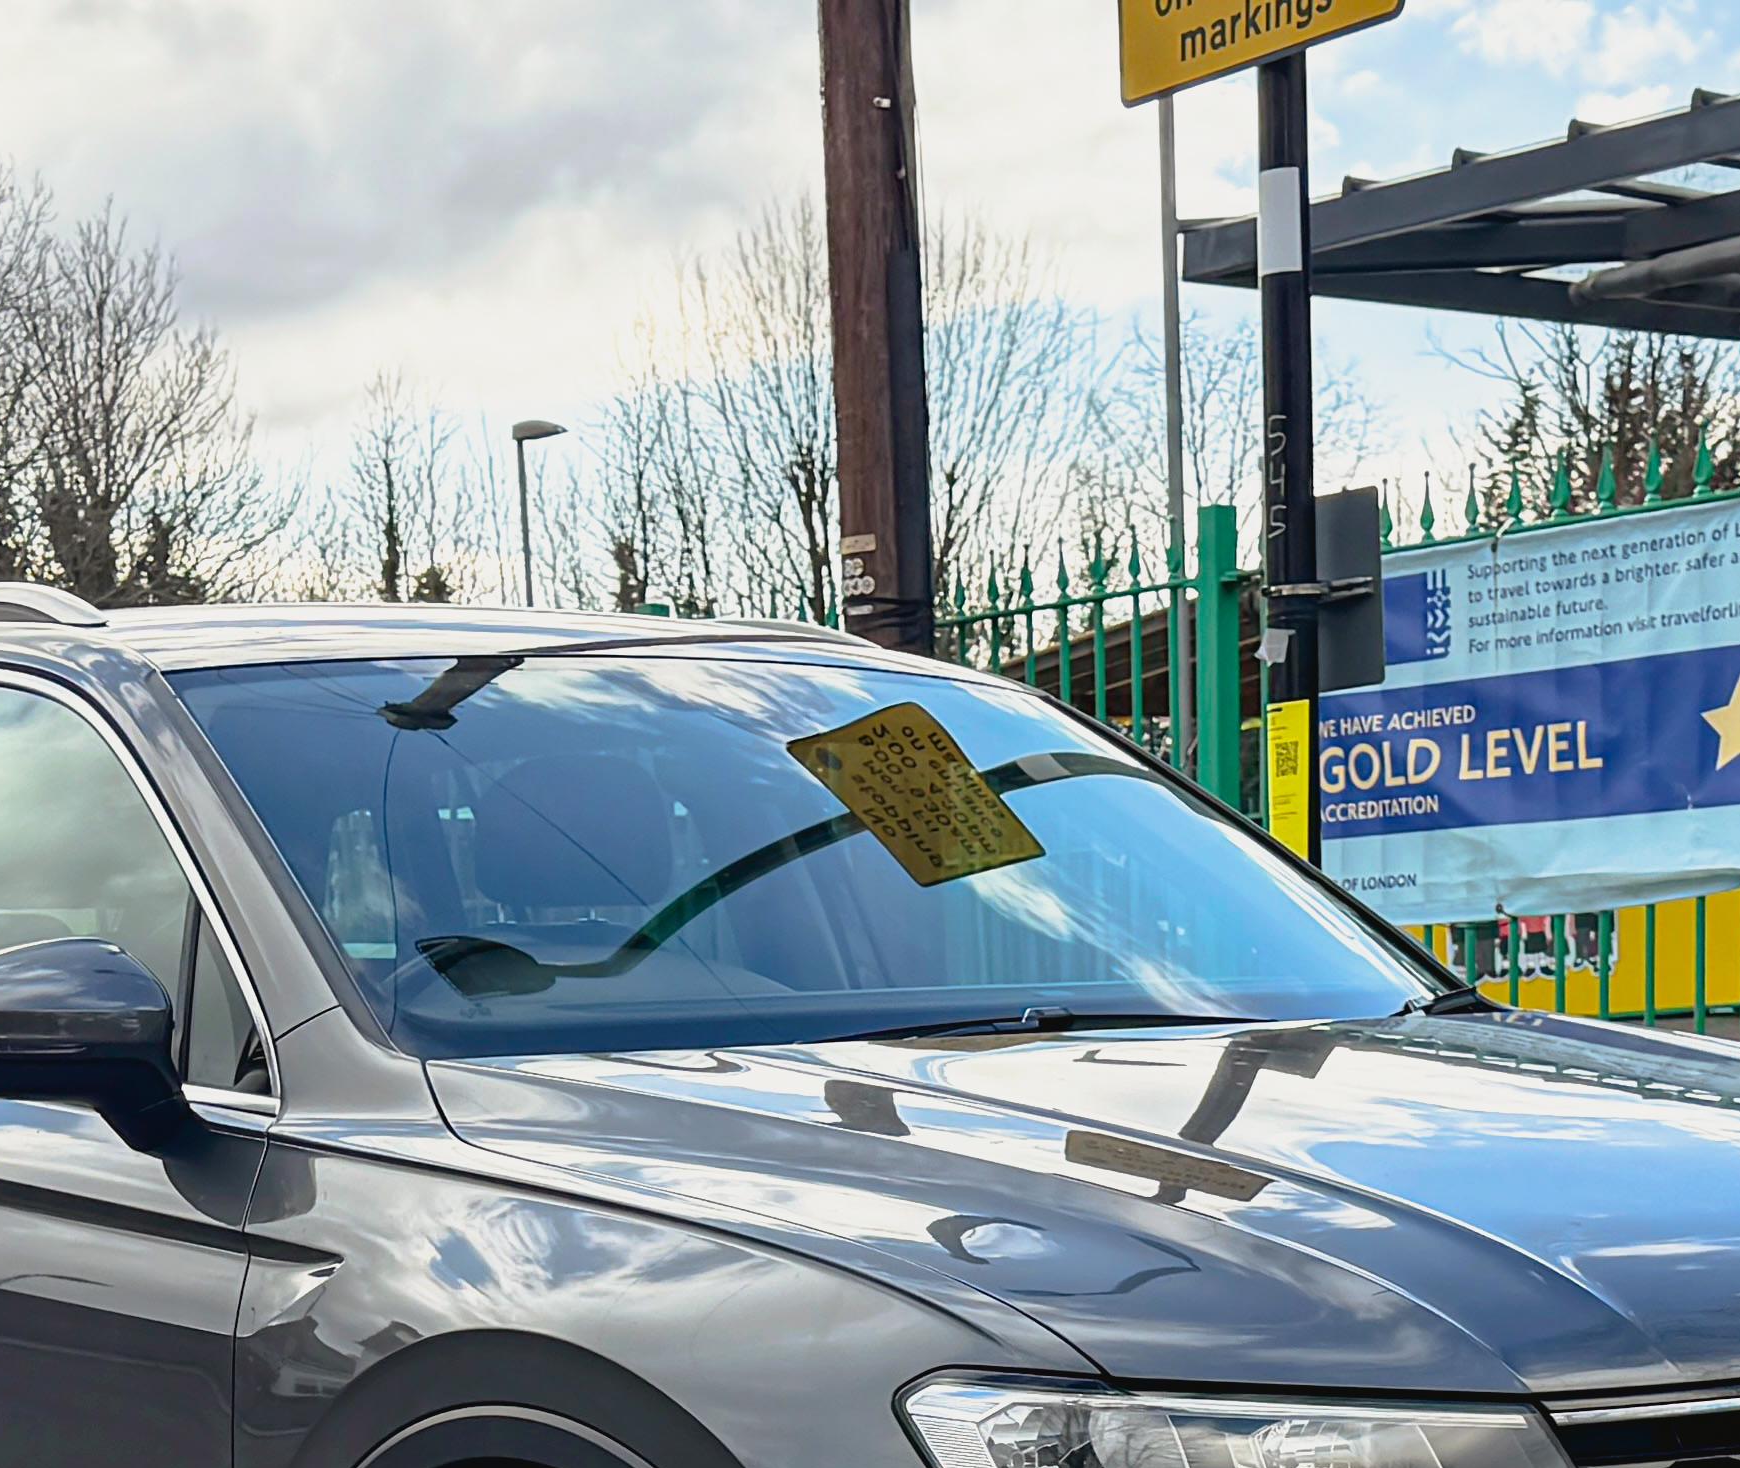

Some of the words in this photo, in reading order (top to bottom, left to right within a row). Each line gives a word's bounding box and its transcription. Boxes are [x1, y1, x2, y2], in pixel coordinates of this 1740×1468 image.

[1467, 556, 1547, 580] Supporting
[1552, 550, 1577, 566] the
[1581, 544, 1617, 561] next
[1622, 531, 1706, 560] generation
[1711, 523, 1729, 541] of
[1468, 590, 1483, 604] to
[1487, 580, 1530, 601] travel
[1536, 572, 1596, 594] towards
[1602, 572, 1610, 585] a
[1685, 552, 1726, 572] safer
[1468, 604, 1550, 628] sustainable
[1556, 597, 1609, 616] future.
[1468, 638, 1489, 654] For
[1495, 634, 1532, 651] more
[1536, 621, 1622, 642] information
[1627, 615, 1657, 632] visit
[1340, 714, 1384, 736] HAVE
[1387, 705, 1476, 731] ACHIEVED
[1319, 738, 1441, 794] GOLD
[1459, 721, 1603, 781] LEVEL
[1342, 877, 1358, 891] OF
[1361, 873, 1417, 891] LONDON
